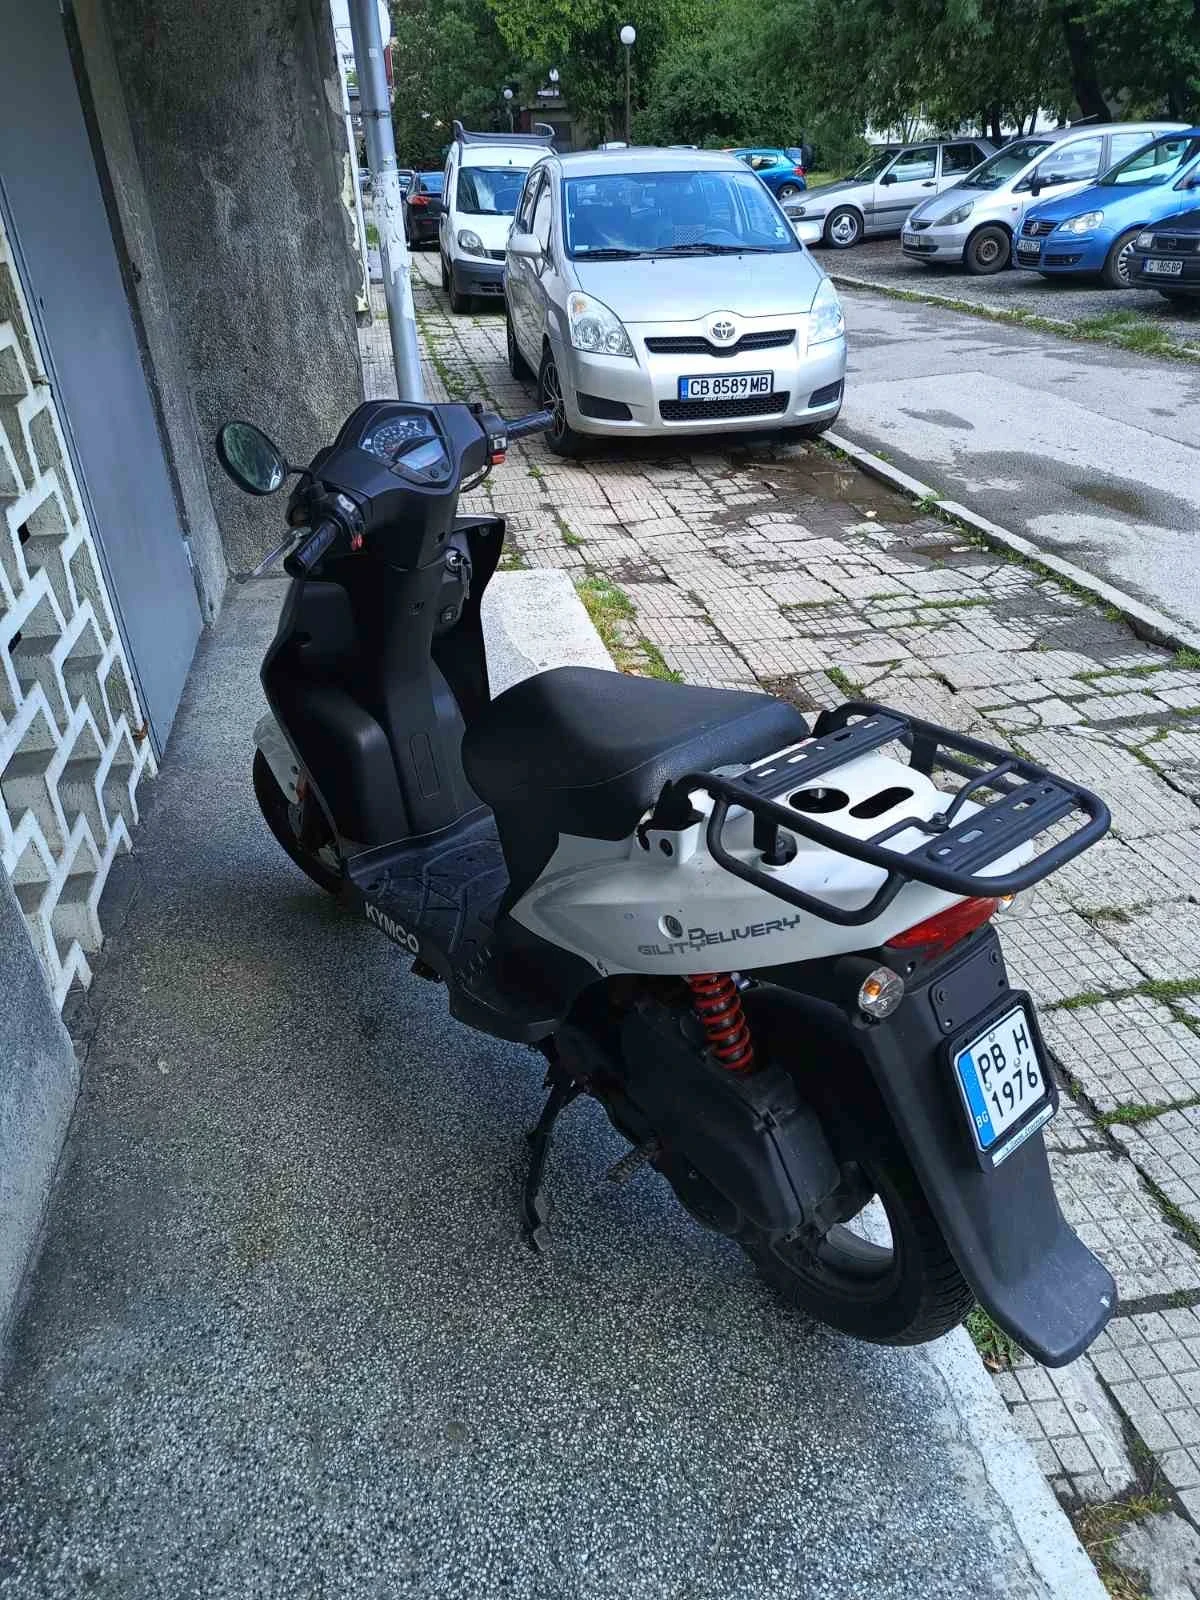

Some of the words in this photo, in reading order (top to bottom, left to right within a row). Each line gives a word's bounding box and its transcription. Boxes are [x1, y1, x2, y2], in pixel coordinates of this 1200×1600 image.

[690, 380, 710, 396] CB
[712, 378, 748, 394] 8589
[749, 376, 769, 392] MB
[364, 901, 419, 953] KYMCO
[687, 914, 801, 945] DELIVERY
[977, 1043, 1007, 1085] PB
[1012, 1023, 1029, 1055] H
[991, 1061, 1038, 1118] 1976
[976, 1112, 989, 1127] BG
